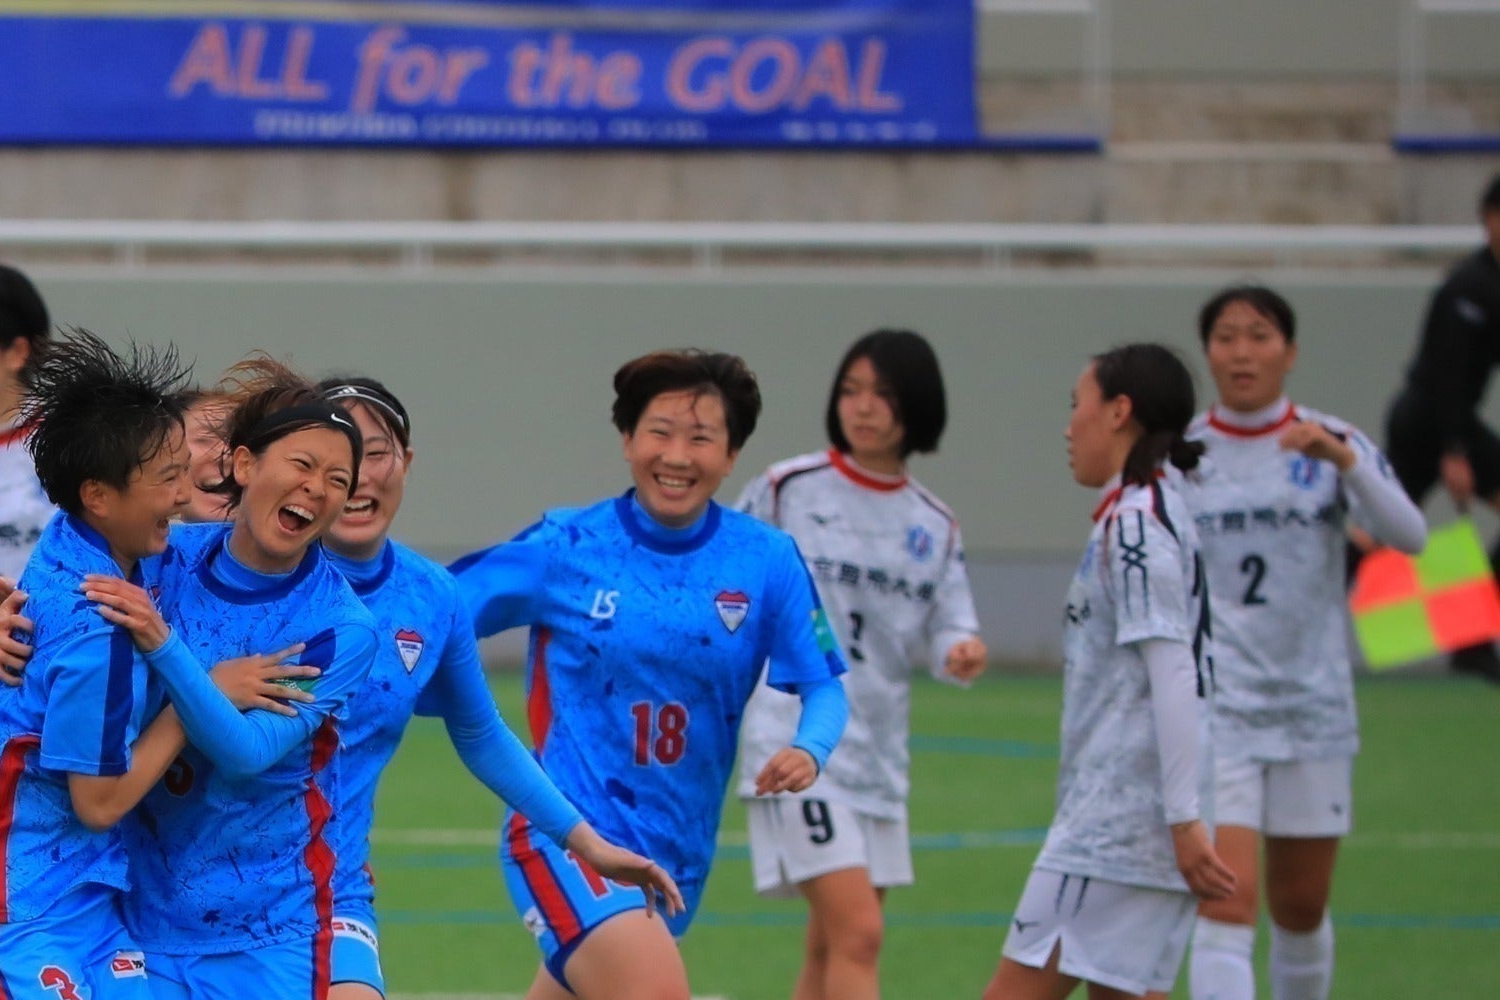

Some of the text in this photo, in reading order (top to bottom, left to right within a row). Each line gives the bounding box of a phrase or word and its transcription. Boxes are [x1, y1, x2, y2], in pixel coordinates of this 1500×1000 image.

[170, 24, 902, 115] ALL for the GOAL
[589, 589, 620, 618] LS
[1240, 554, 1268, 605] 2
[631, 700, 689, 767] 18
[802, 799, 833, 845] 9
